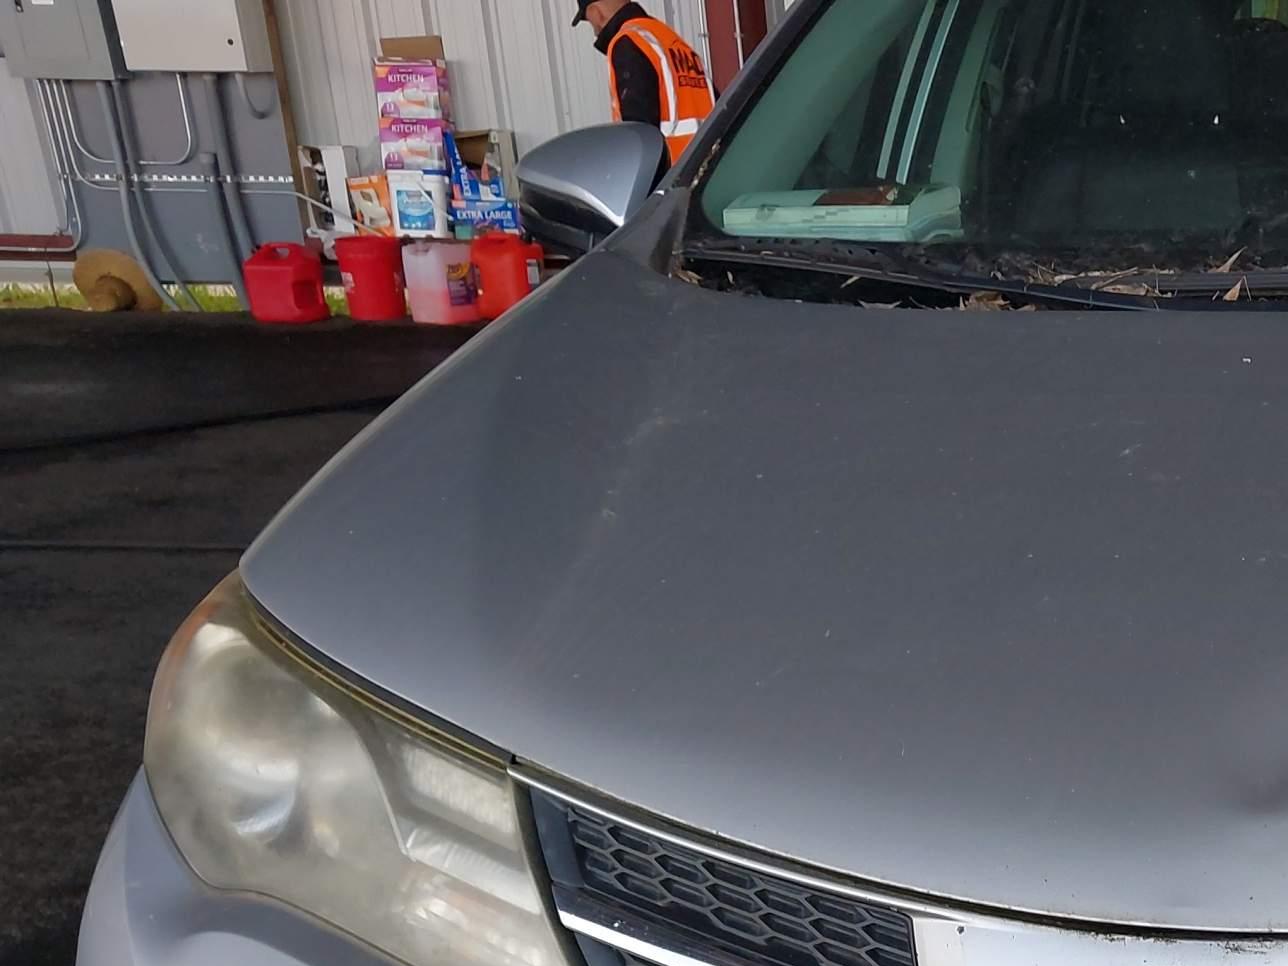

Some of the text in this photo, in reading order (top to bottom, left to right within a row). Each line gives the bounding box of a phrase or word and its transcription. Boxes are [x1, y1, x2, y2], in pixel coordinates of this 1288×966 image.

[387, 73, 424, 83] KITCHEN
[391, 124, 428, 133] KITCHEN
[456, 209, 513, 219] EXTRA LARGE
